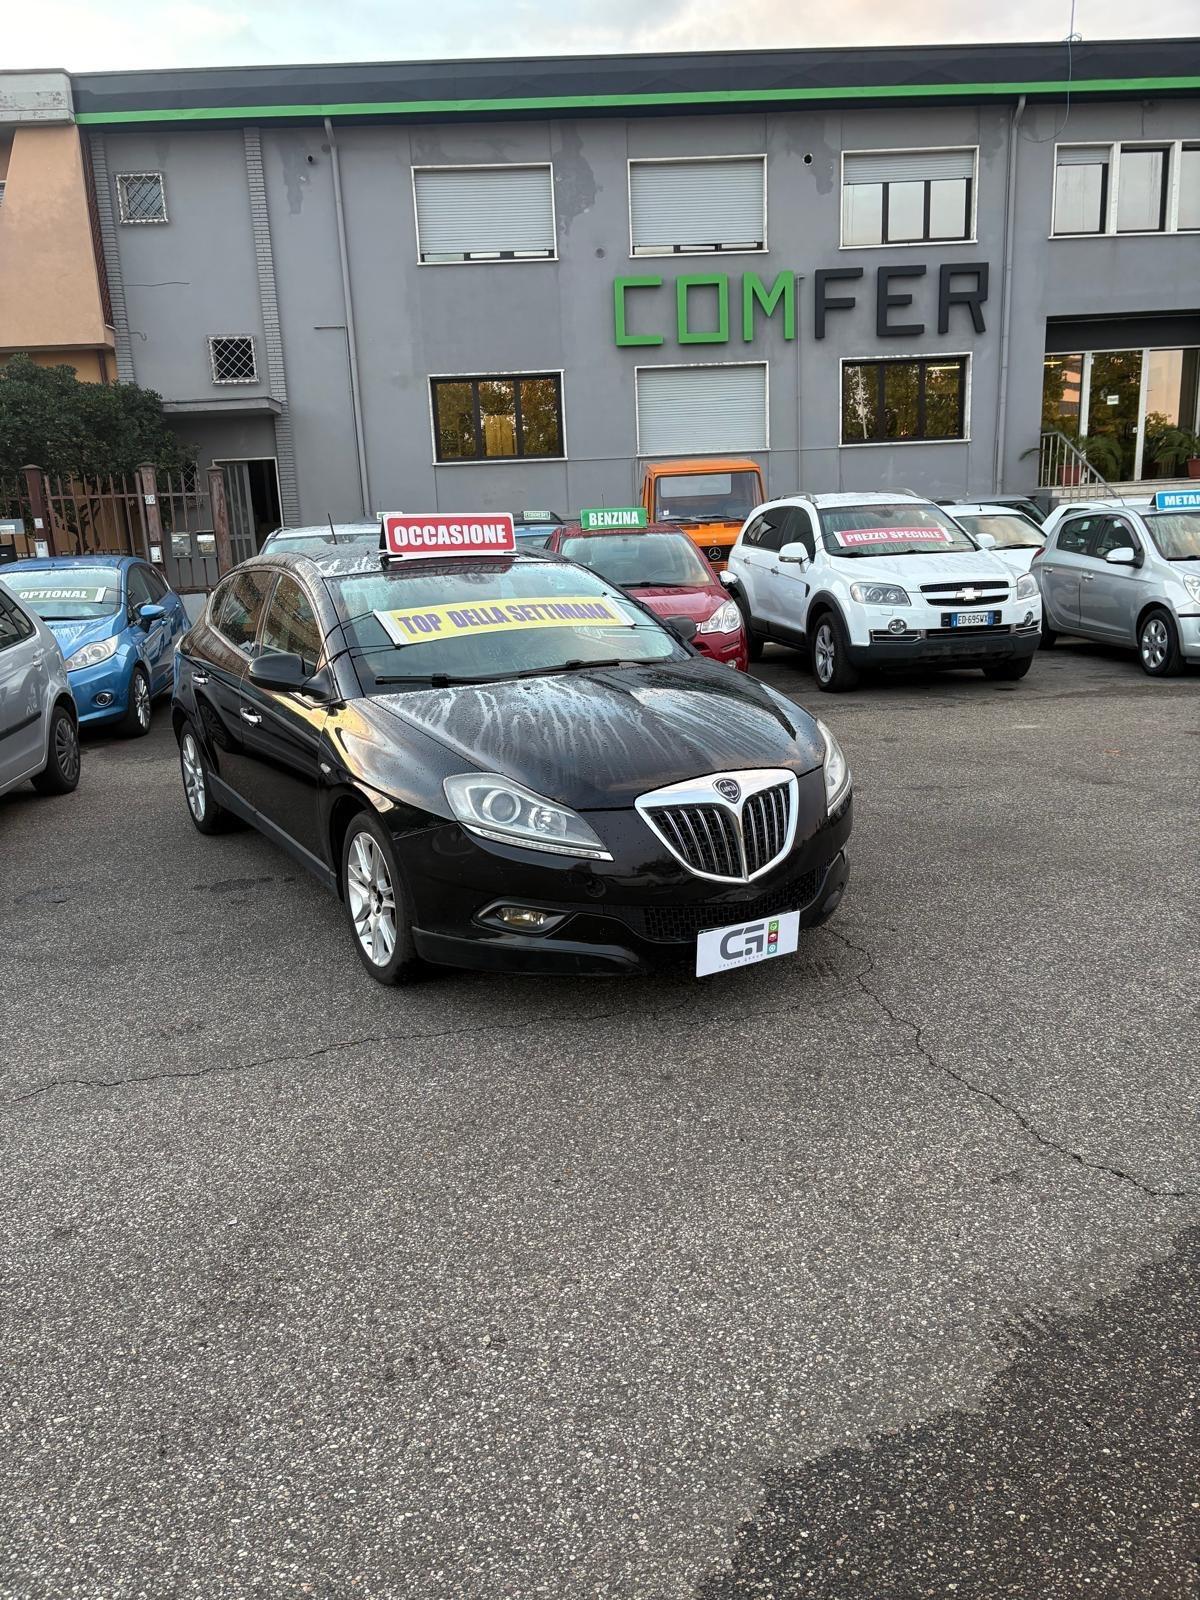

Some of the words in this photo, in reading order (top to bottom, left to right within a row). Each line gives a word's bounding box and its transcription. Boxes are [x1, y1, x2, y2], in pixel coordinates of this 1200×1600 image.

[614, 262, 989, 346] COMFER
[588, 511, 640, 526] BENZINA
[393, 524, 507, 546] OCCASIONE
[845, 531, 888, 542] PREZZO
[888, 530, 943, 539] SPECIALE
[19, 589, 88, 599] OPTIONAL
[397, 613, 442, 634] TOP
[447, 606, 512, 628] DELLA
[507, 603, 615, 621] SETTIMANA
